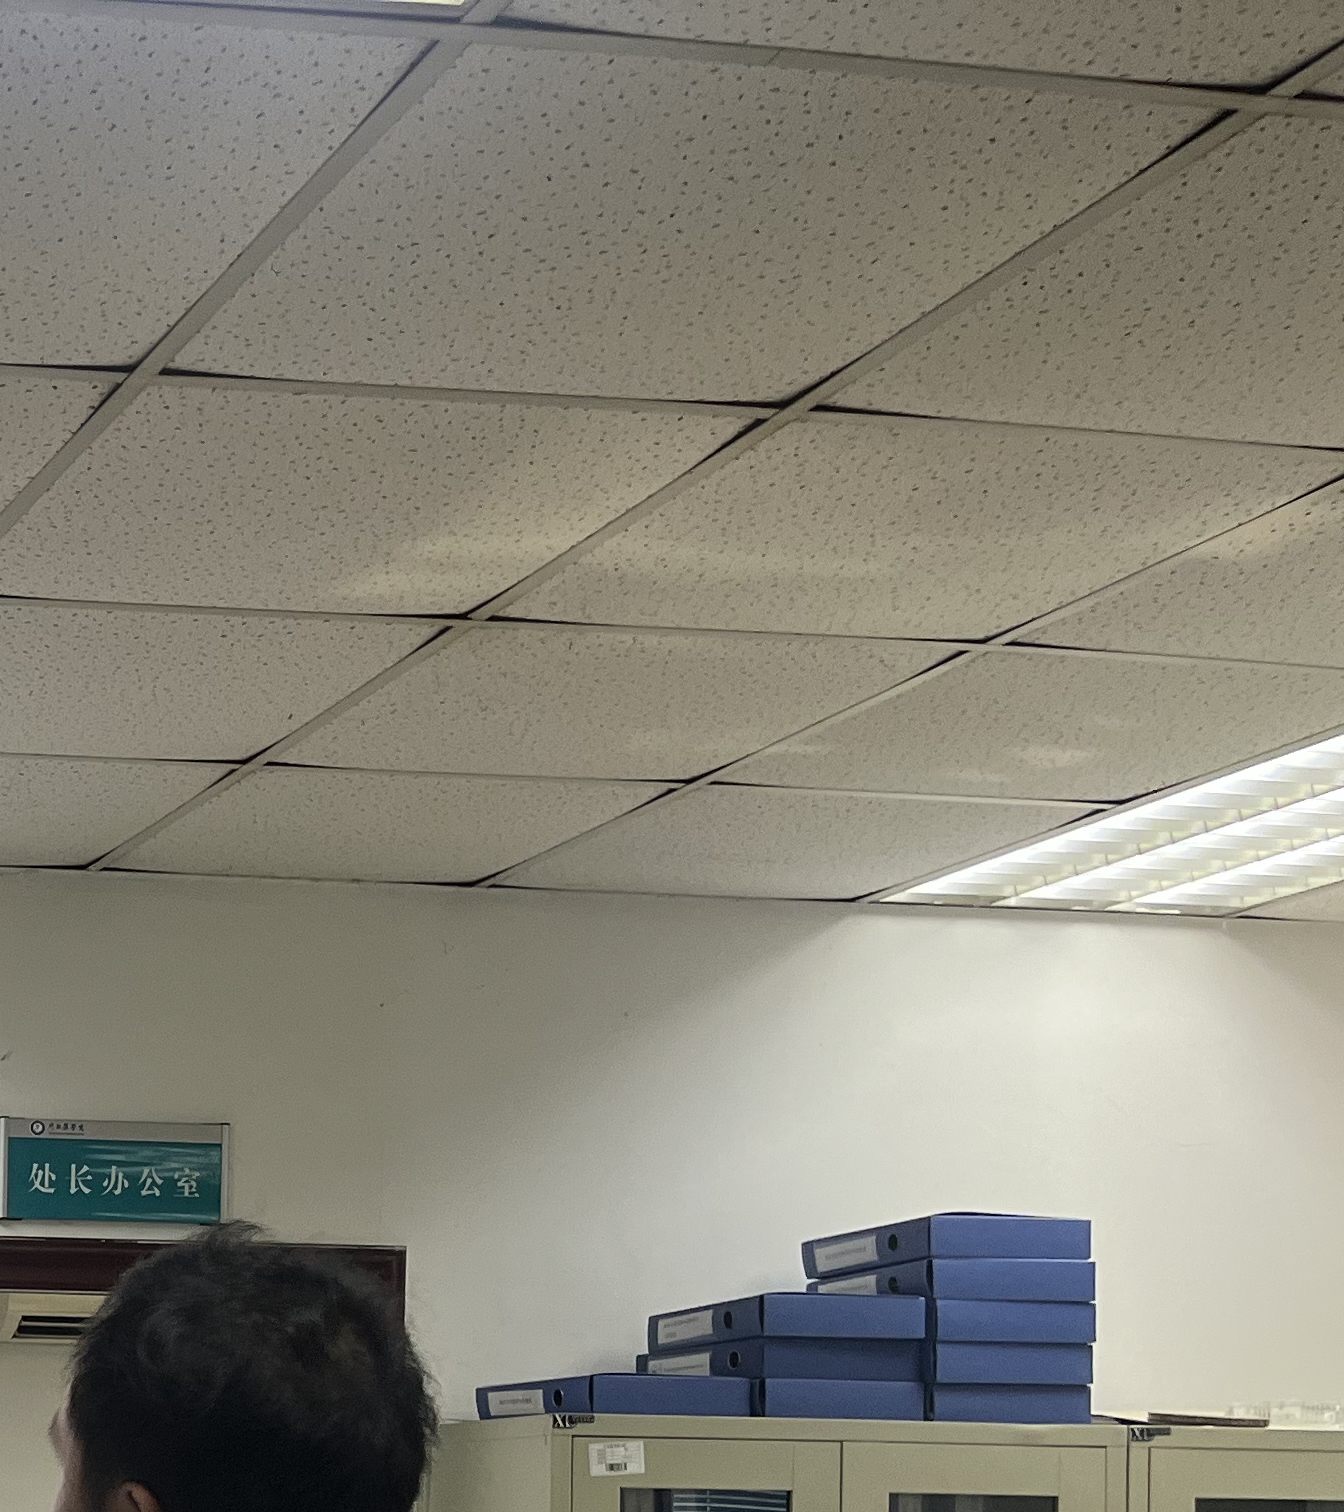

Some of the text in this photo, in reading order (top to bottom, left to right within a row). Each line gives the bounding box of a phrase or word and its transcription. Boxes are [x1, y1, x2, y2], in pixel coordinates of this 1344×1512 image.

[28, 1162, 201, 1198] 处长办公室
